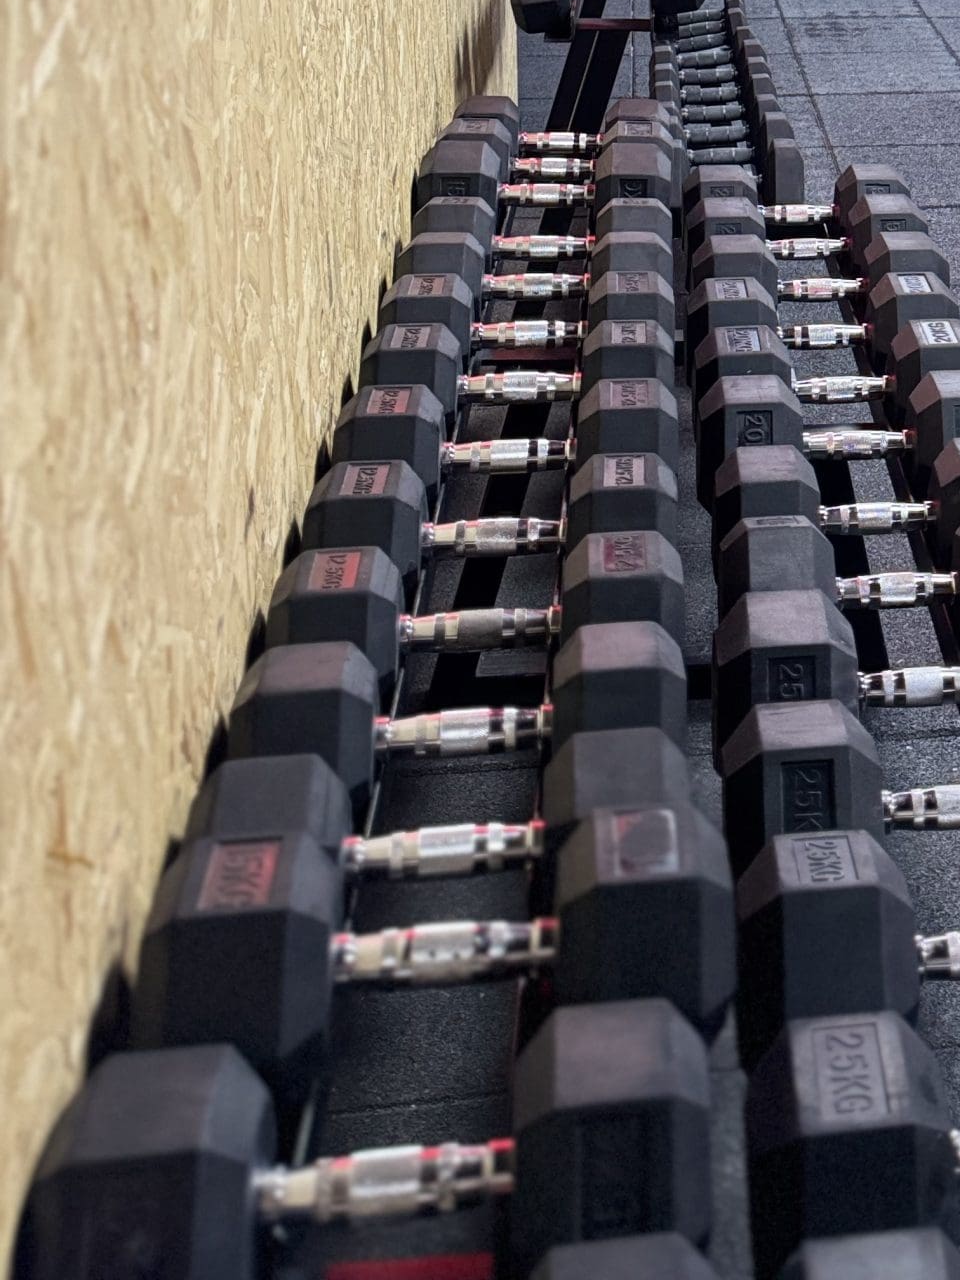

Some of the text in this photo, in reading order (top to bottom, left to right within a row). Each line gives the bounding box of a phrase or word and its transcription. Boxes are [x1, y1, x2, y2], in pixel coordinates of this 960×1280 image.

[928, 323, 951, 342] 20KG
[744, 416, 765, 443] 20
[779, 664, 805, 698] 25
[795, 769, 823, 830] 25K
[806, 841, 844, 882] 25KG
[825, 1034, 873, 1115] 25KG
